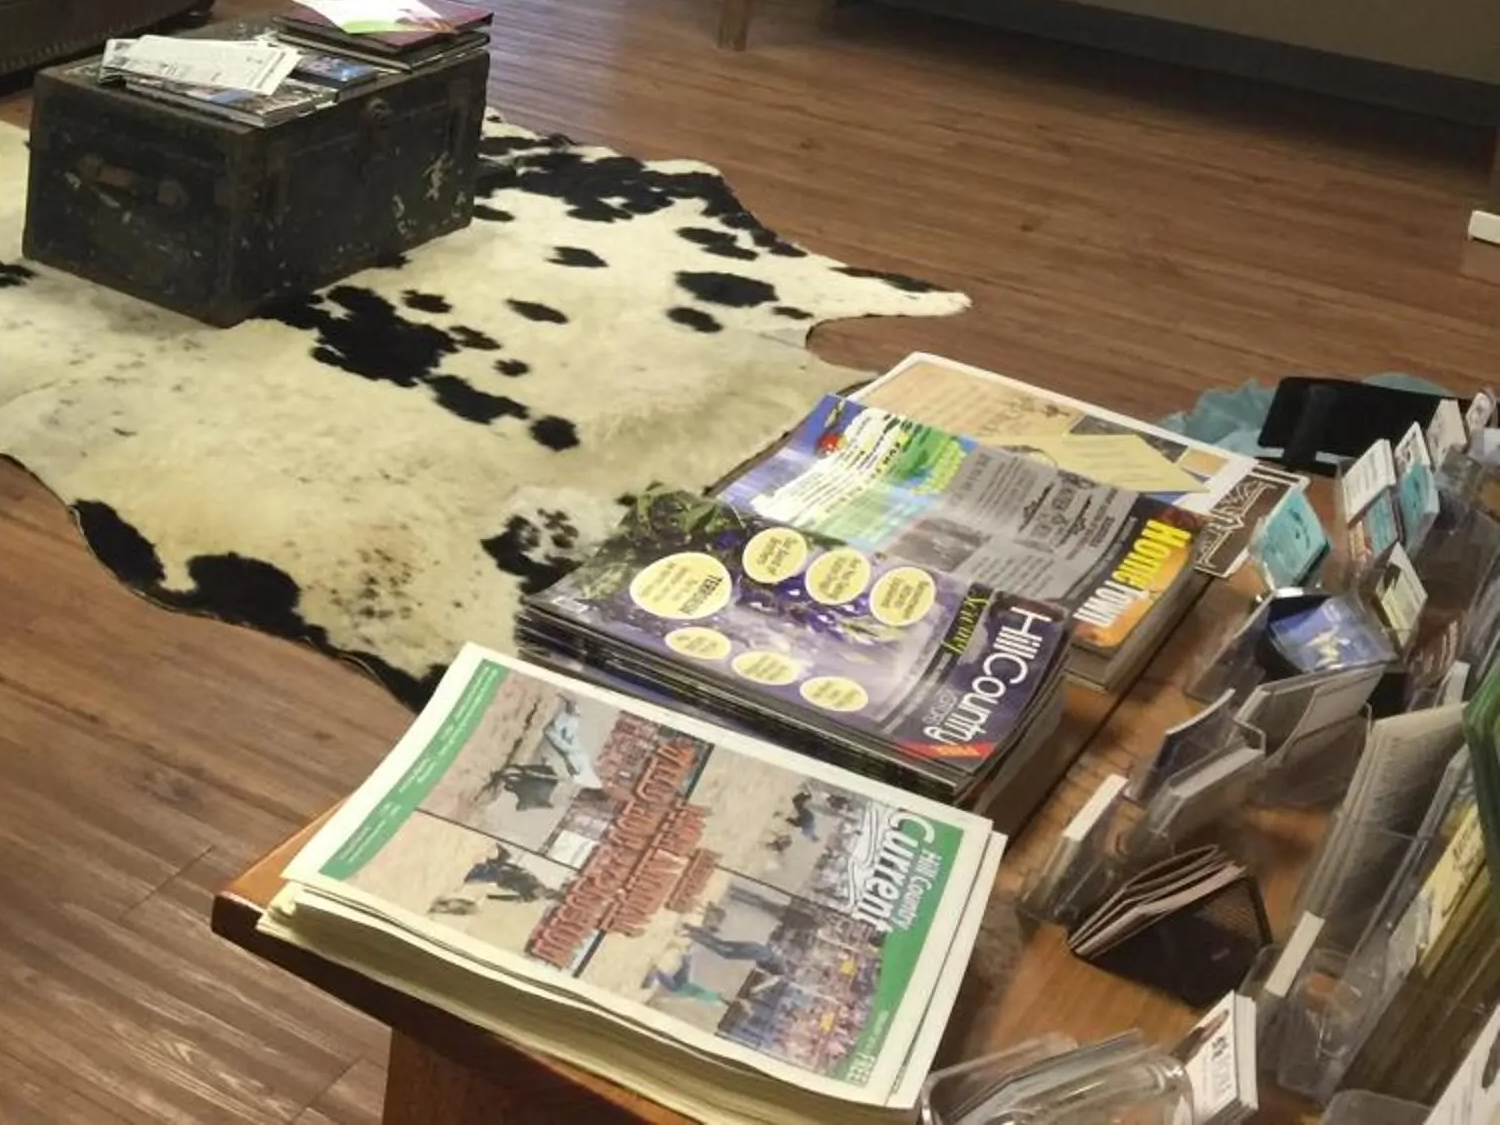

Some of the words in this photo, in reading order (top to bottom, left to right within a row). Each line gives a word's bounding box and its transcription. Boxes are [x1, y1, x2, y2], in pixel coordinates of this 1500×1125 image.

[851, 811, 934, 932] Current
[915, 850, 942, 879] Hill
[893, 875, 932, 929] Country
